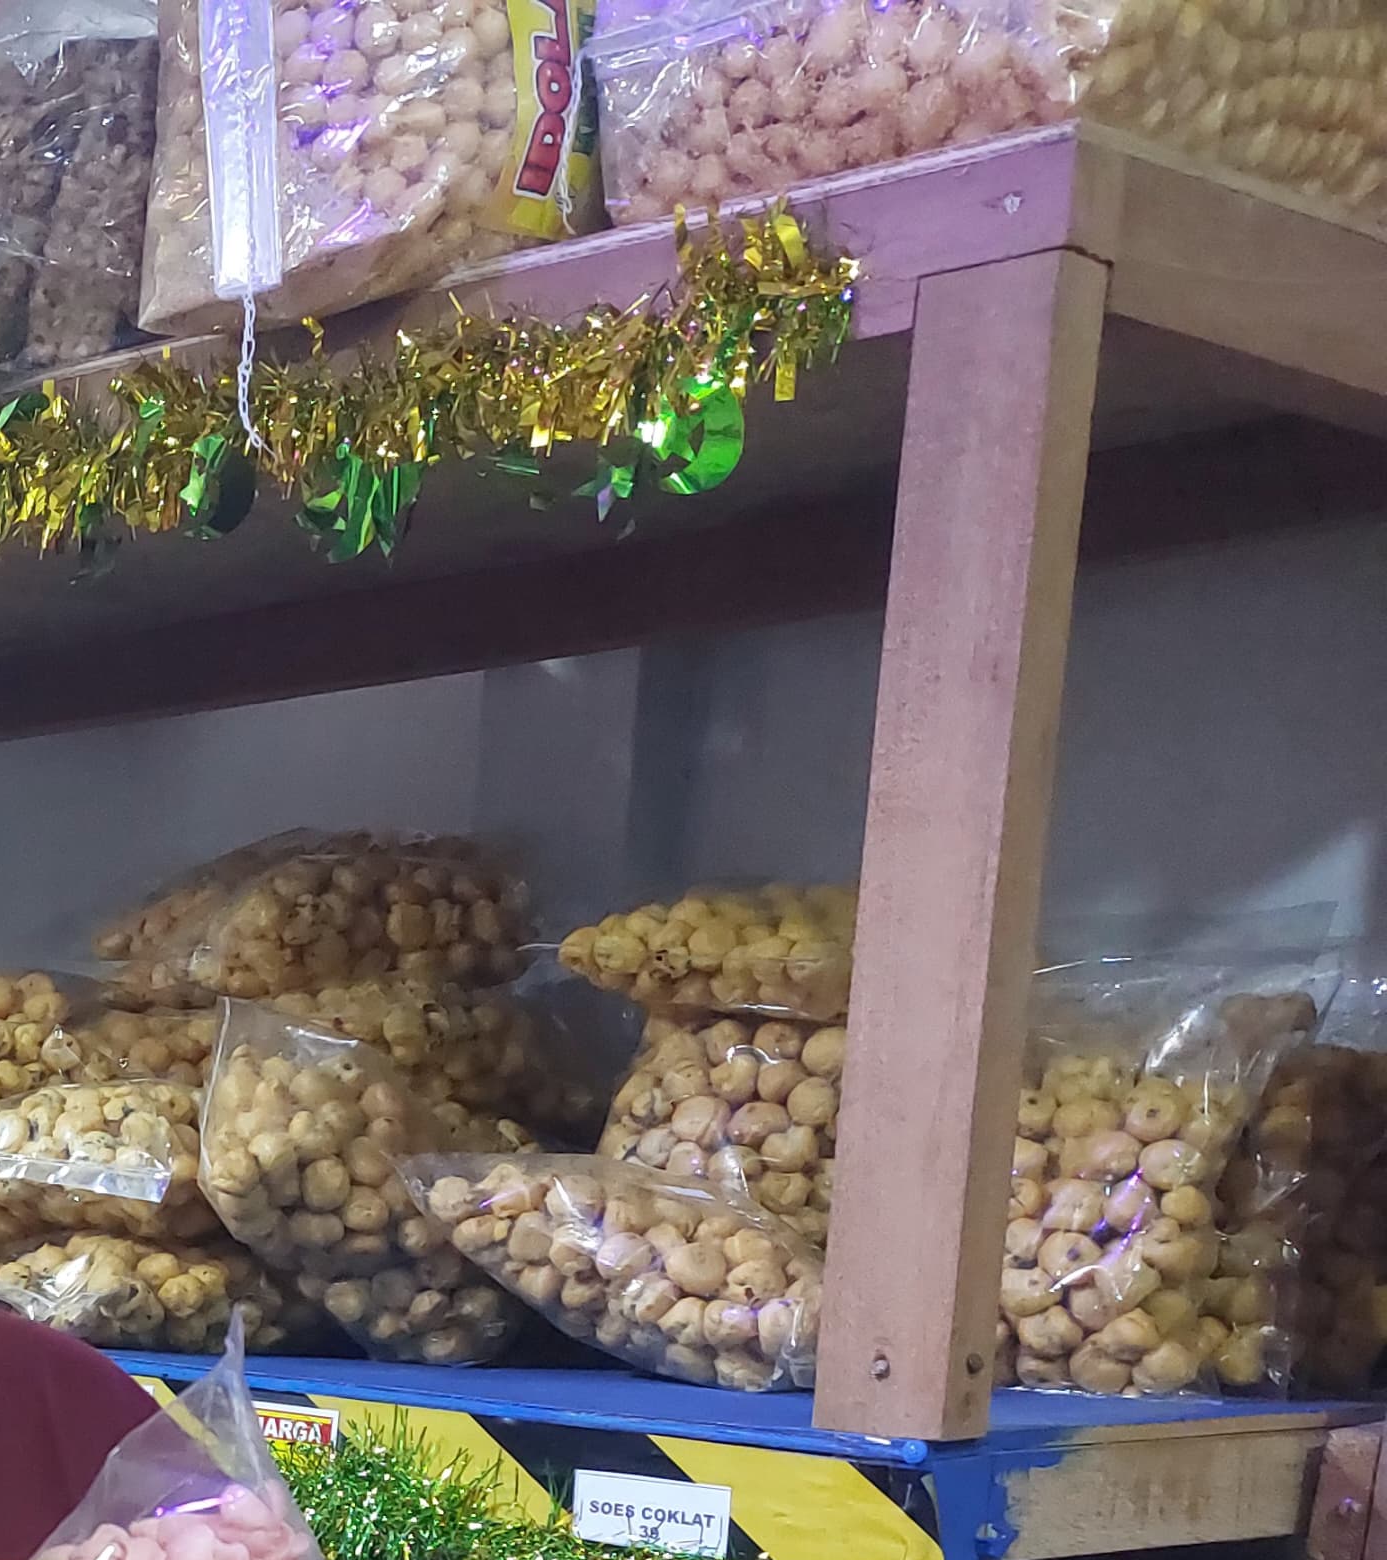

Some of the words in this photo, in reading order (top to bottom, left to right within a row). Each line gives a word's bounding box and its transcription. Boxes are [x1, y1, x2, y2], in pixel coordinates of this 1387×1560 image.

[514, 0, 573, 198] IDOL
[589, 1500, 635, 1518] SOES
[641, 1507, 715, 1528] COKLAT
